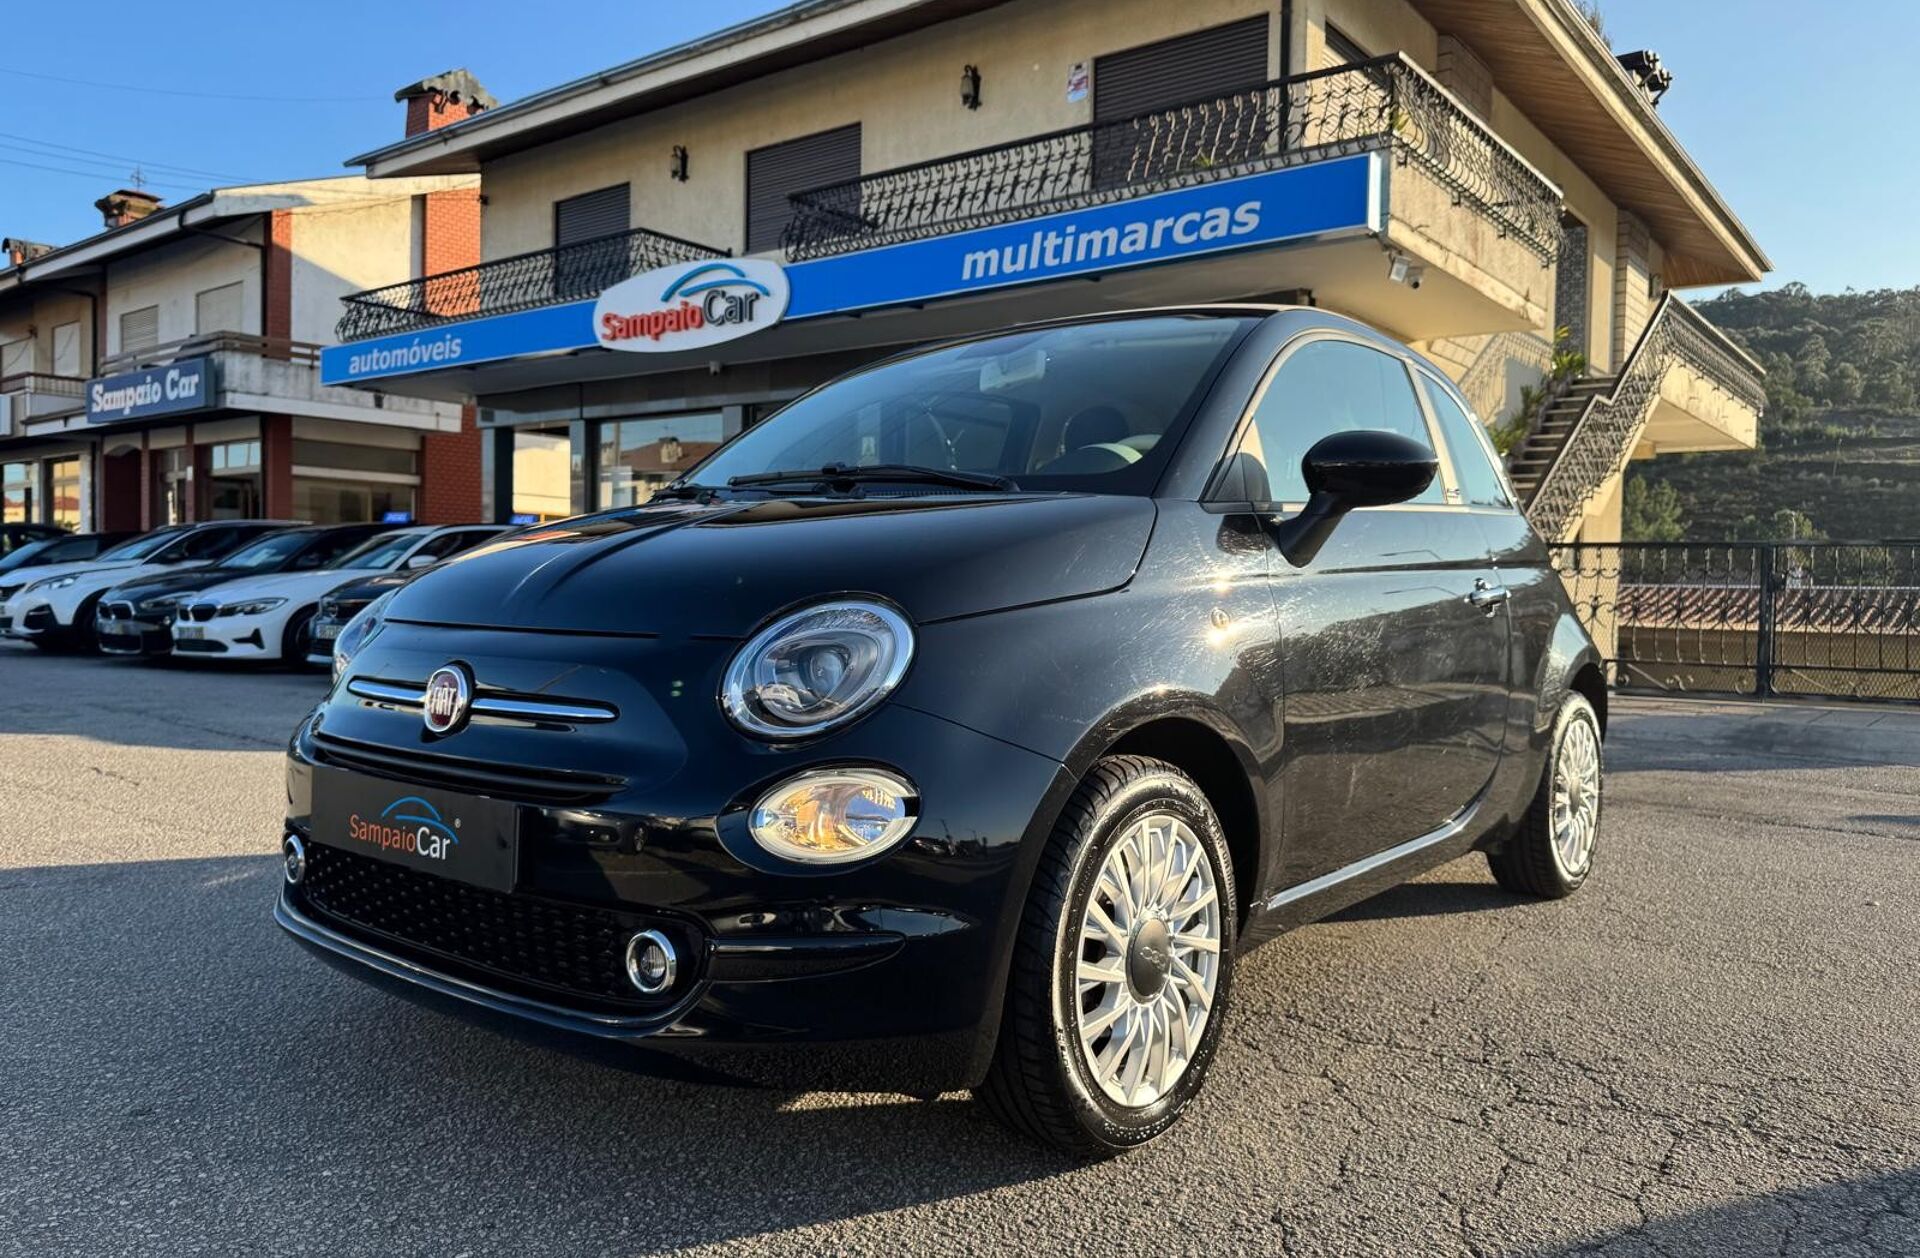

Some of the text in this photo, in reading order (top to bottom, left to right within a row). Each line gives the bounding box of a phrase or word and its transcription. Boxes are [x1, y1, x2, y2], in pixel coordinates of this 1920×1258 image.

[961, 201, 1261, 280] multimarcas
[348, 334, 462, 375] automóveis
[91, 368, 199, 415] Sampaio Car
